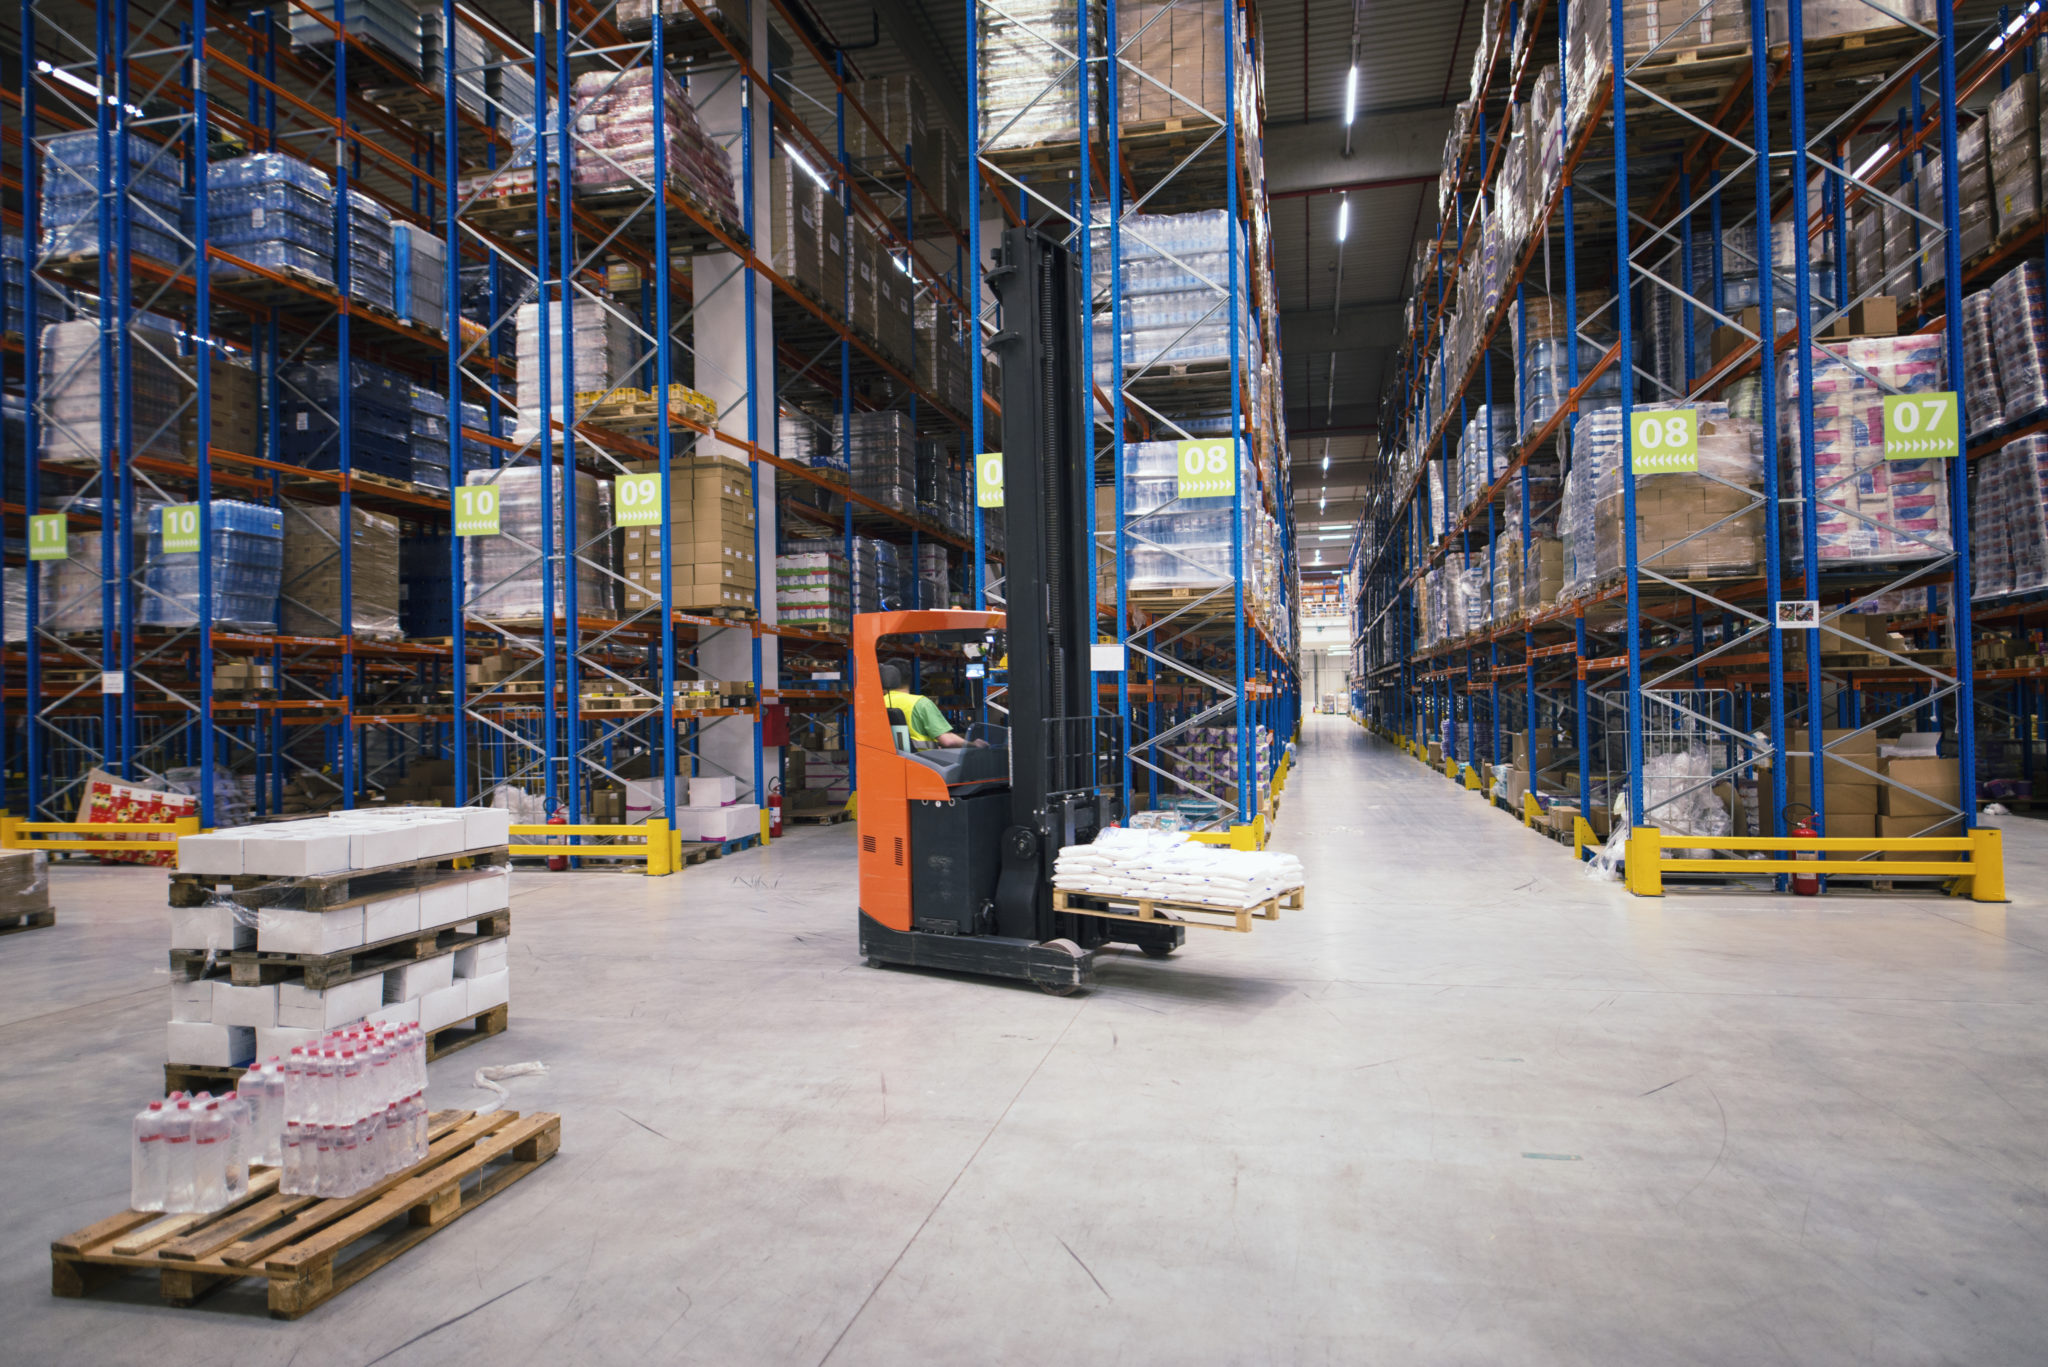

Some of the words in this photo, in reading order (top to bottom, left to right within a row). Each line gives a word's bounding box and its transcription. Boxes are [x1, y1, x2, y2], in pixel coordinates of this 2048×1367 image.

[1893, 399, 1948, 433] 07
[1638, 417, 1689, 449] 08
[1184, 446, 1229, 475] 08
[462, 490, 494, 516] 10
[621, 479, 656, 506] 09
[34, 519, 59, 542] 11
[167, 510, 196, 534] 10
